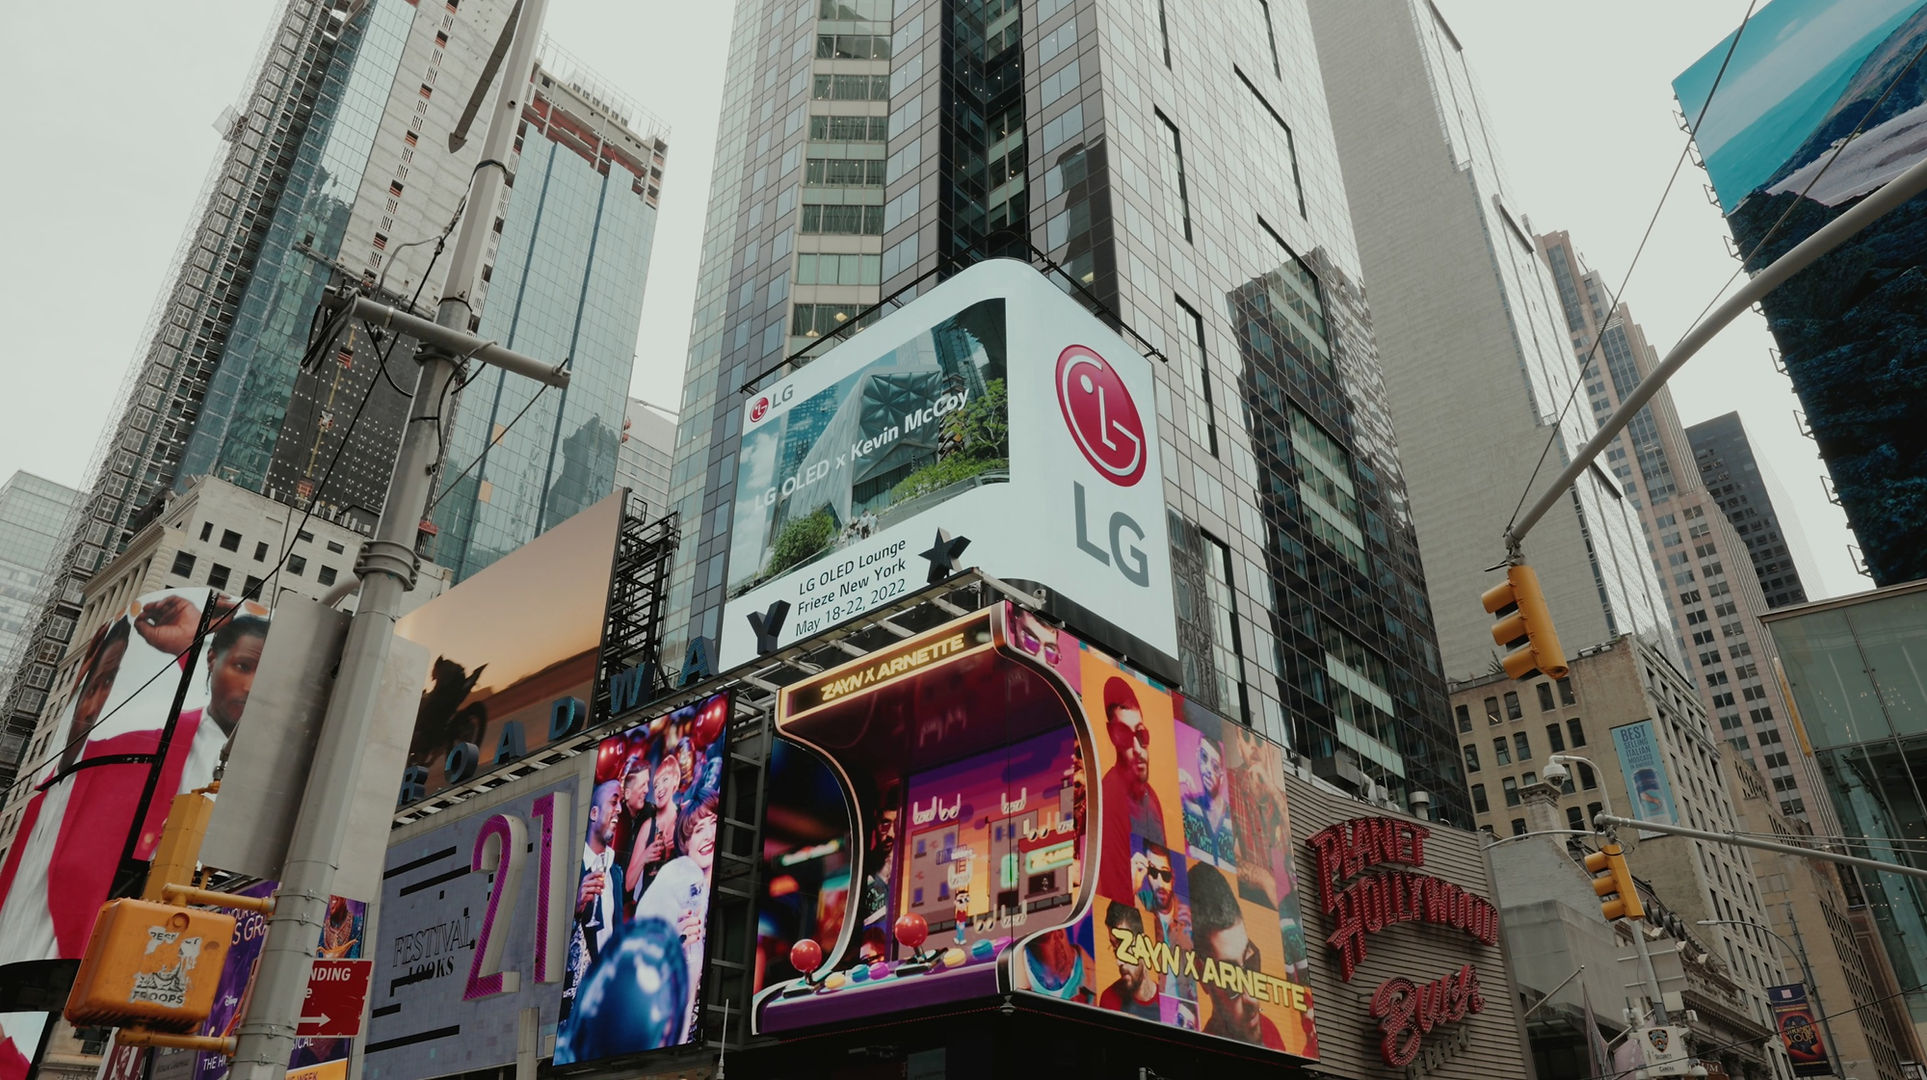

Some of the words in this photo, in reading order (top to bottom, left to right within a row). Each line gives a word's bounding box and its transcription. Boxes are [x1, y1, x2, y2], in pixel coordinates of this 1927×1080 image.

[772, 384, 793, 409] LG
[754, 487, 776, 511] LG
[782, 459, 829, 496] OLED
[851, 424, 899, 461] Kevin
[905, 388, 970, 434] McCoy
[1074, 480, 1150, 588] LG
[797, 590, 835, 616] Frieze
[839, 575, 869, 598] New
[874, 558, 906, 582] York
[799, 578, 815, 596] LG
[819, 560, 854, 586] OLED
[859, 539, 906, 568] Lounge
[795, 617, 821, 637] May
[825, 597, 866, 623] 18-22,
[871, 578, 906, 605] 2022
[820, 671, 864, 701] ZAYN
[876, 633, 965, 680] ARNETTE
[1620, 725, 1646, 742] BEST
[1623, 737, 1649, 749] SELLING
[1625, 745, 1651, 757] ITALIAN
[1305, 816, 1430, 916] PLANET
[463, 792, 570, 1001] 21
[393, 916, 472, 968] FESTIVAL
[1326, 871, 1498, 983] HOLLYWOOD
[132, 990, 184, 1004] TROOPS
[1111, 928, 1180, 977] ZAYN
[1202, 957, 1308, 1012] ARNETTE
[203, 1056, 218, 1071] THE
